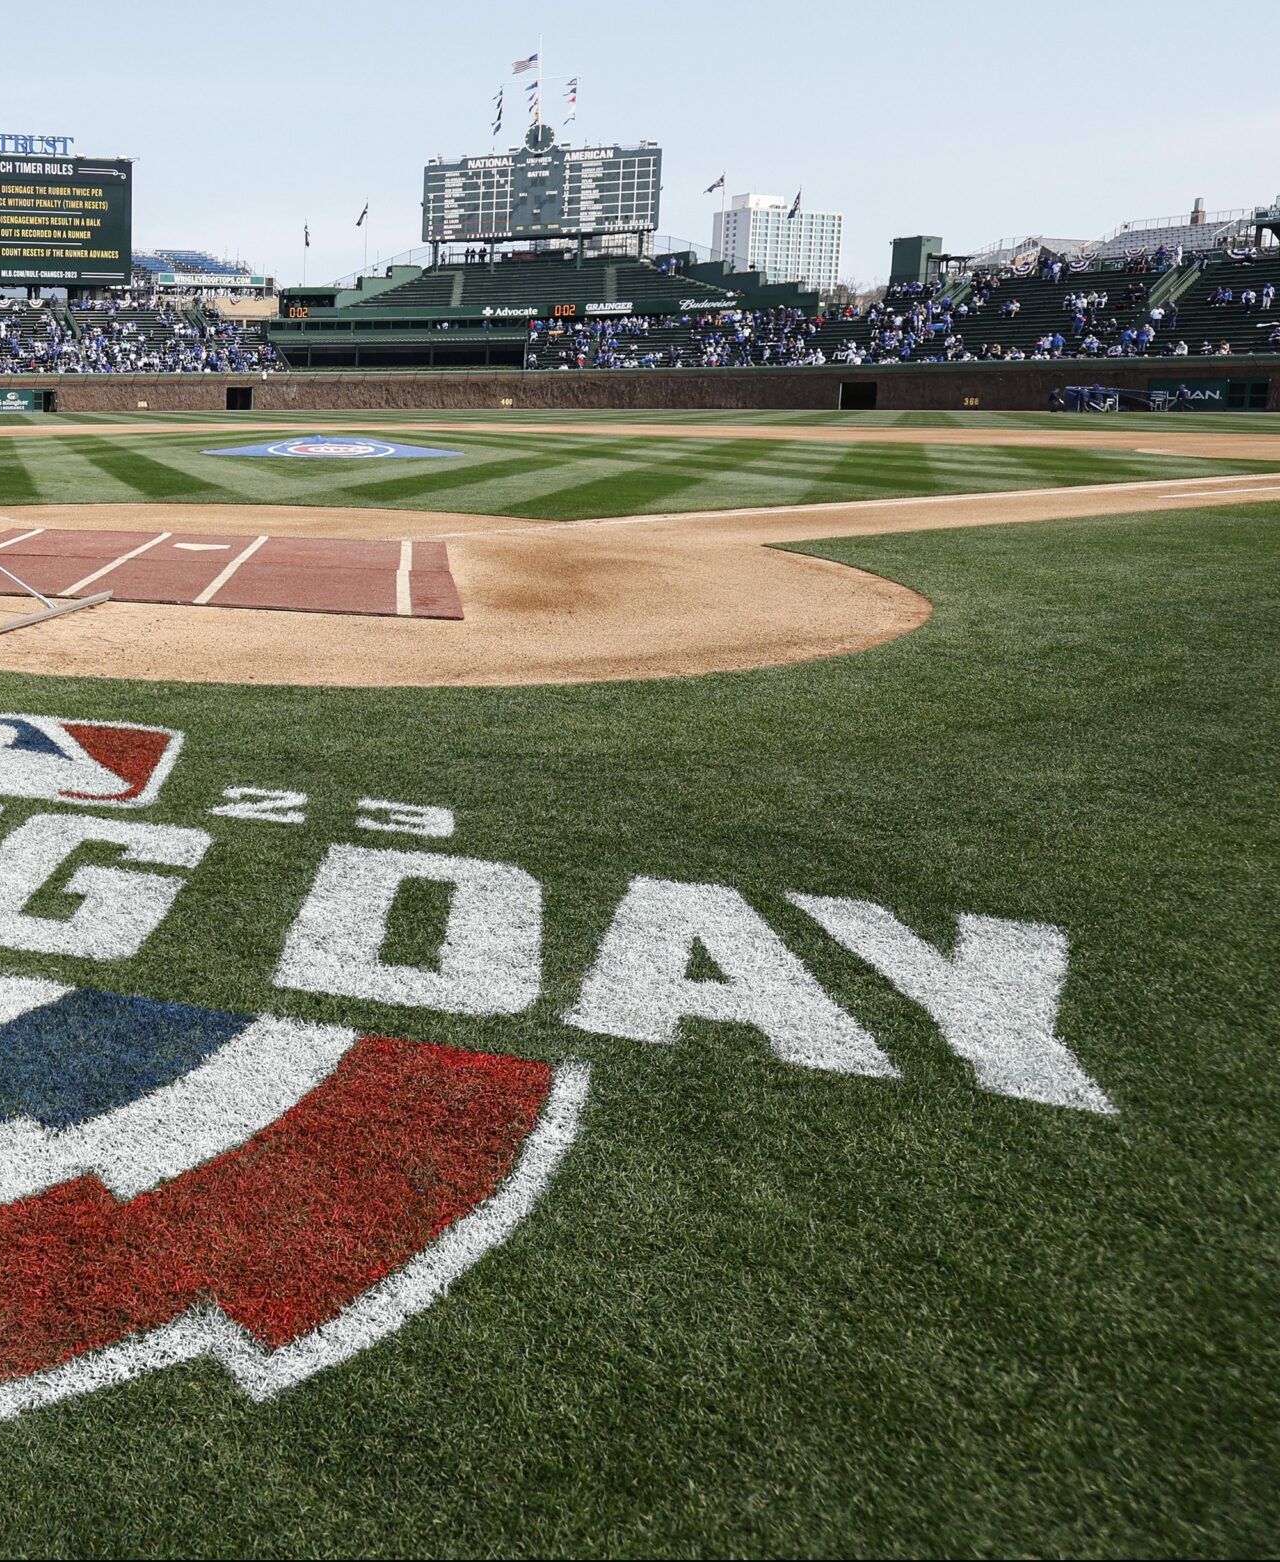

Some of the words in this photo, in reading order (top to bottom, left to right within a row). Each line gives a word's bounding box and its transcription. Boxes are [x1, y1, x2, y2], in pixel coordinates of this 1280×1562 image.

[563, 149, 614, 161] AMERICAN
[14, 161, 43, 175] TIMER
[44, 162, 73, 176] RULES
[467, 157, 515, 169] NATIONAL
[2, 185, 34, 195] DISENGAGE
[35, 186, 47, 195] THE
[48, 186, 71, 196] RUBBER
[72, 187, 90, 196] TWICE
[91, 188, 102, 197] PER
[7, 198, 34, 208] WITHOUT
[35, 198, 61, 209] PENALTY
[63, 199, 83, 209] (TIMER
[84, 200, 109, 211] RESETS)
[50, 217, 72, 226] RESULT
[73, 218, 79, 226] IN
[80, 218, 85, 226] A
[86, 218, 101, 227] BALK
[0, 228, 13, 237] OUT
[14, 229, 20, 237] IS
[21, 229, 52, 239] RECORDED
[53, 230, 62, 239] ON
[62, 230, 67, 239] A
[68, 230, 91, 239] RUNNER
[1, 247, 21, 257] COUNT
[22, 248, 44, 257] RESETS
[45, 249, 51, 257] IF
[53, 249, 64, 258] THE
[65, 249, 88, 259] RUNNER
[89, 250, 119, 259] ADVANCES
[0, 269, 78, 279] MLB.COM/RULE-CHANGES-2023
[174, 274, 251, 284] WRIGLEYROOFTOPS.COM
[554, 304, 576, 316] 0:02
[585, 302, 633, 311] GRAINGER
[679, 299, 738, 310] Budweiser
[289, 307, 308, 318] 0:02
[495, 307, 538, 316] Advocate
[208, 785, 457, 838] 23
[273, 840, 1120, 1118] DAY
